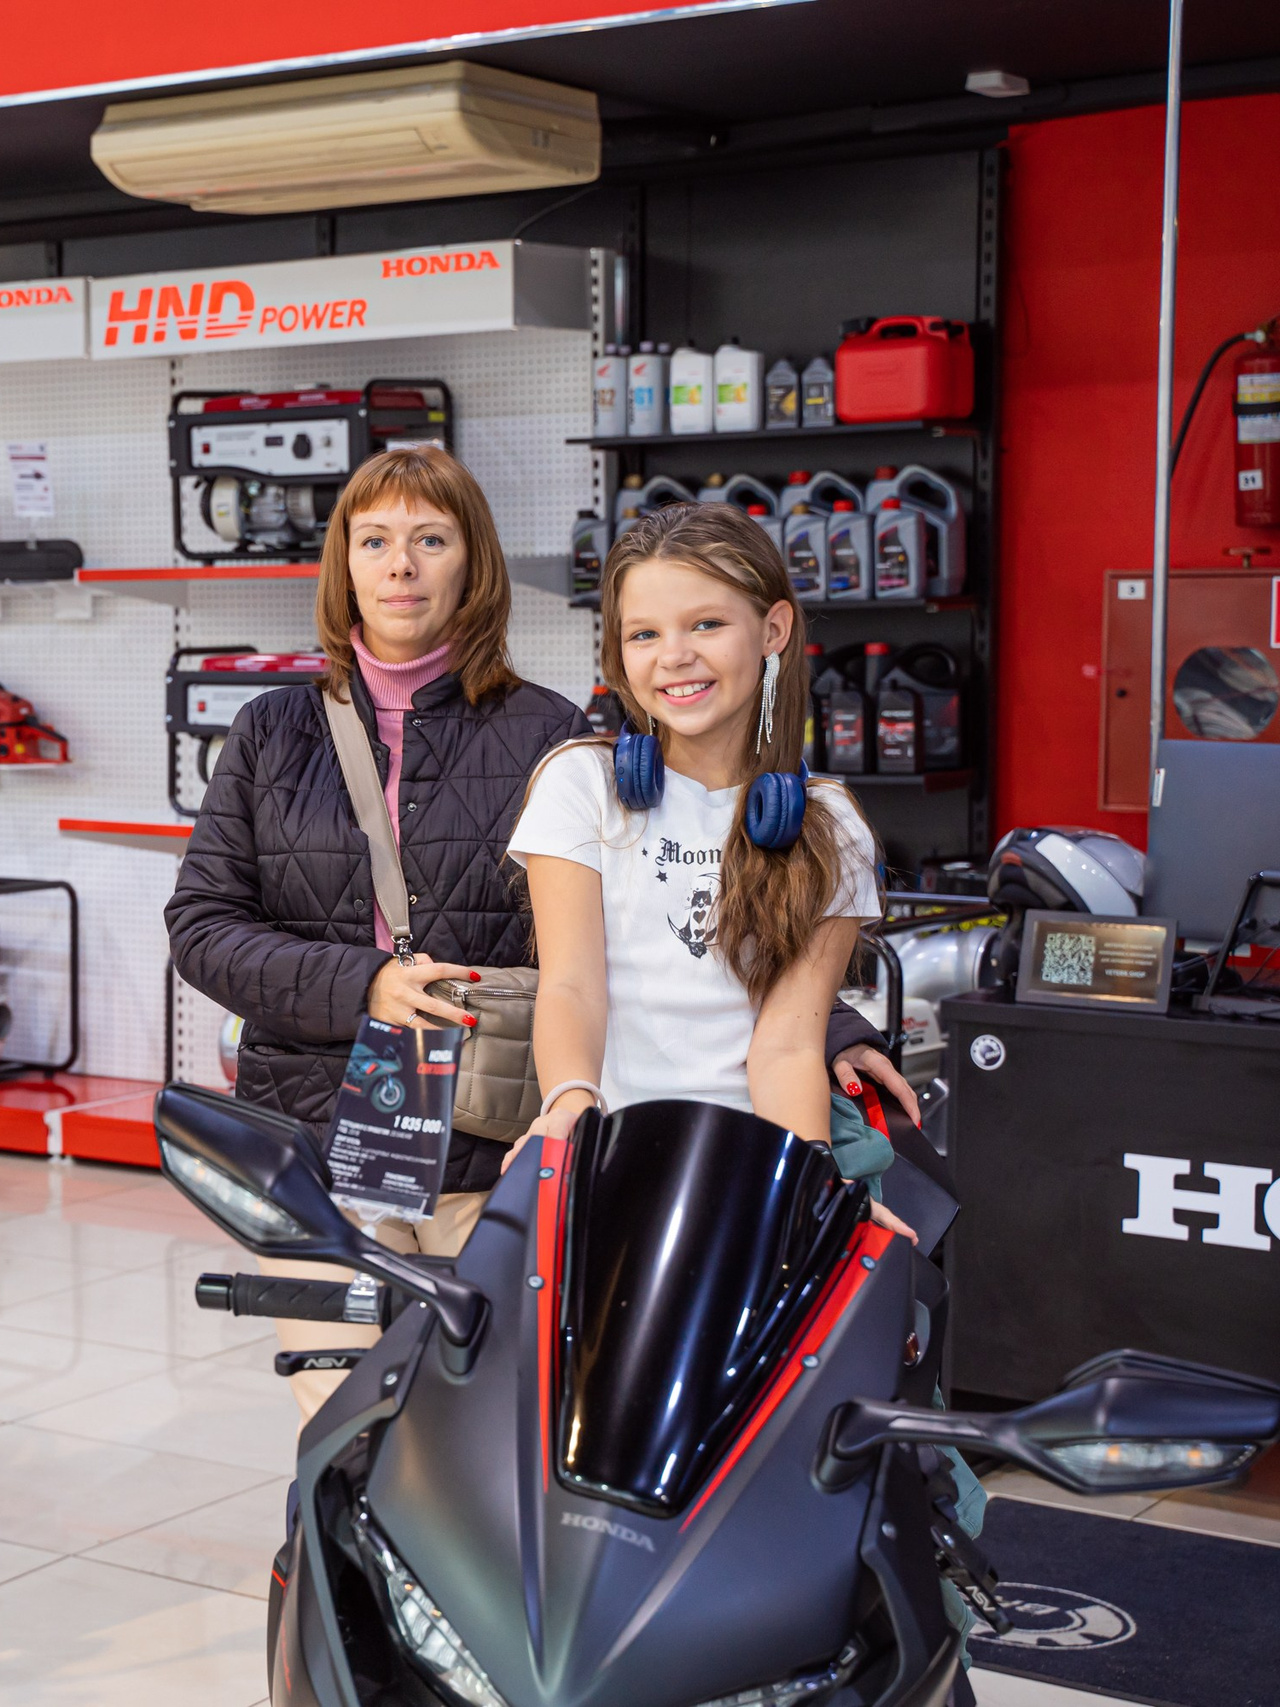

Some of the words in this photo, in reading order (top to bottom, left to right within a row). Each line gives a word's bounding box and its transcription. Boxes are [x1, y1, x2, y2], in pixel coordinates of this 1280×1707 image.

[380, 250, 500, 278] HONDA
[104, 280, 255, 346] HND
[258, 299, 368, 334] POWER
[393, 1115, 400, 1128] 1
[1122, 1153, 1280, 1251] H
[303, 1357, 347, 1369] ASV
[561, 1511, 655, 1553] HONDA
[965, 1585, 996, 1612] ASV
